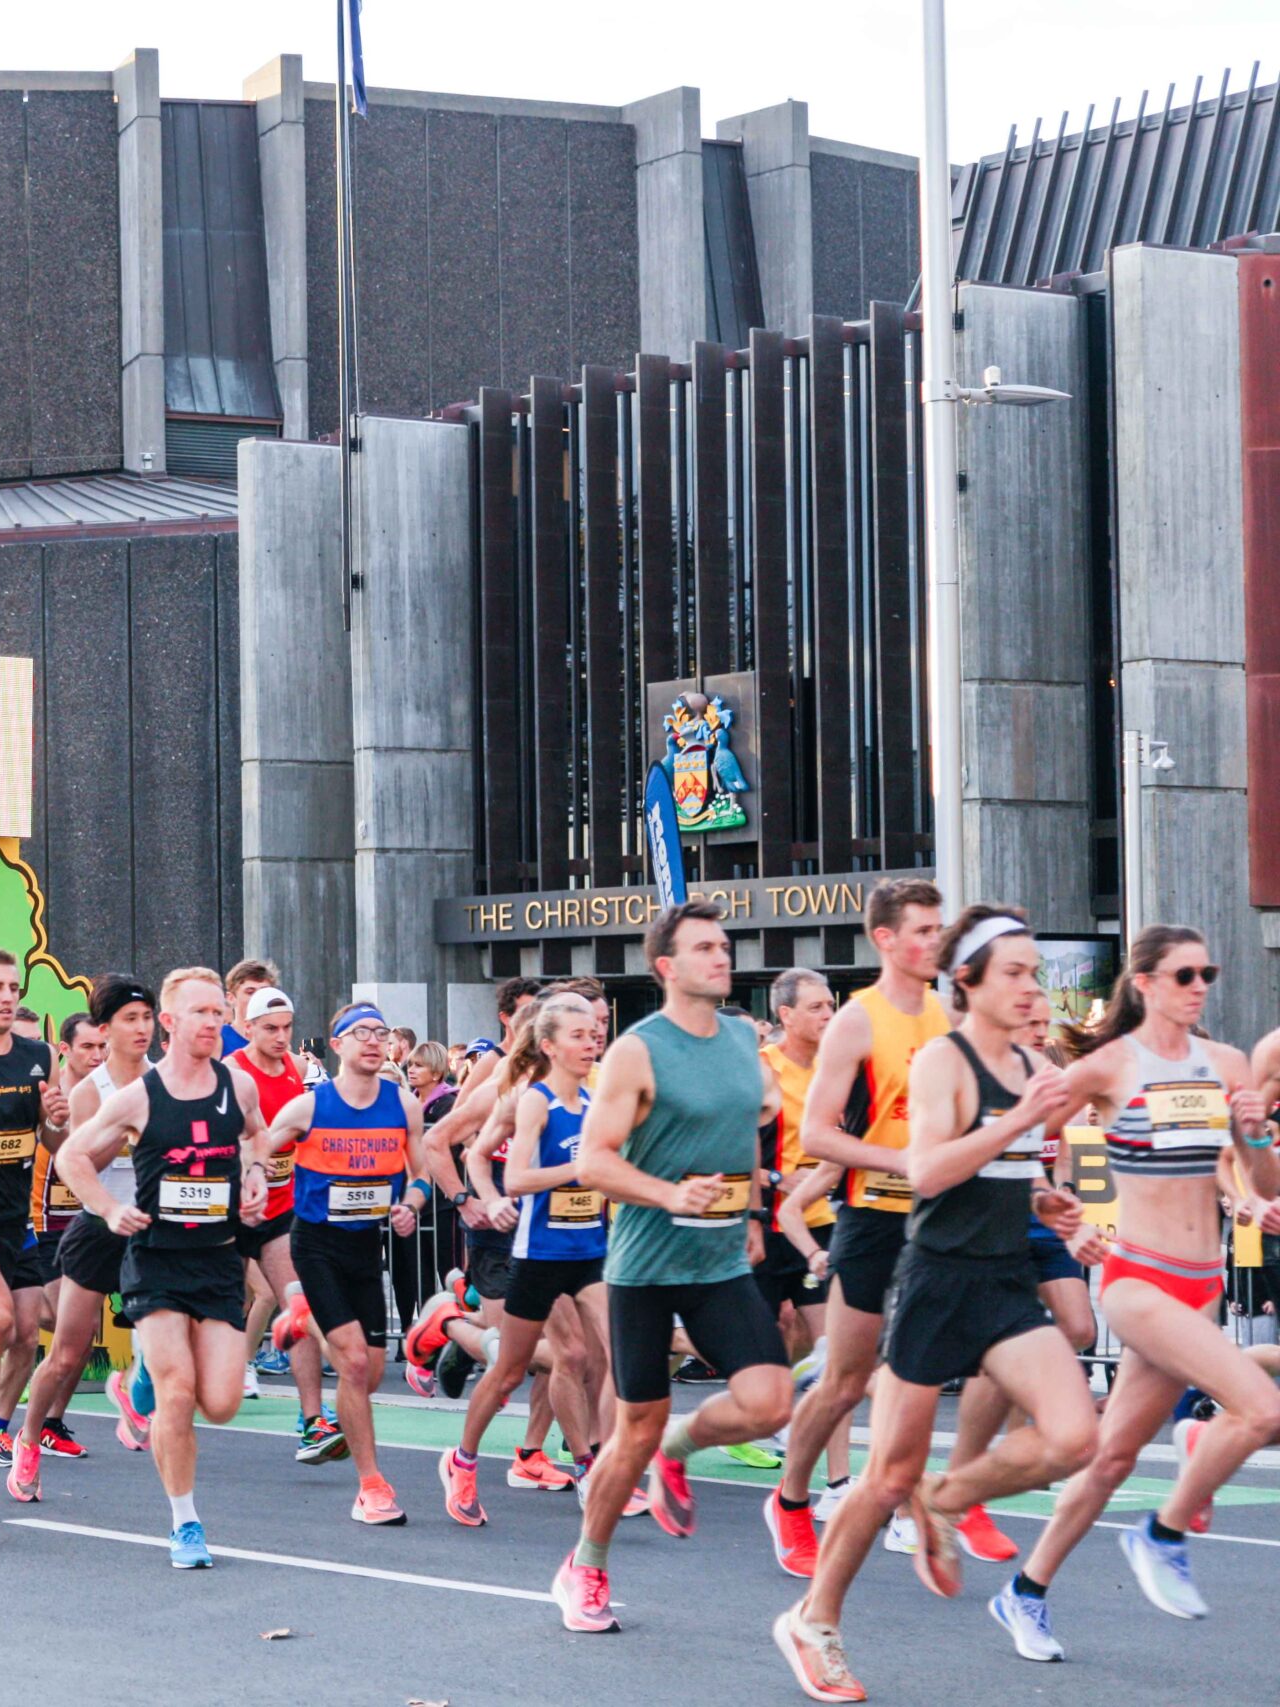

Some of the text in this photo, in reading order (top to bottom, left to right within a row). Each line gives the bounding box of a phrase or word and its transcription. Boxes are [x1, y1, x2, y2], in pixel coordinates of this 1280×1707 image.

[464, 883, 862, 932] THE CHRISTCHCH TOWN
[322, 1138, 400, 1153] CHRISTCHURCH
[348, 1155, 376, 1169] AVON
[180, 1187, 211, 1199] 5319
[347, 1190, 375, 1201] 5518
